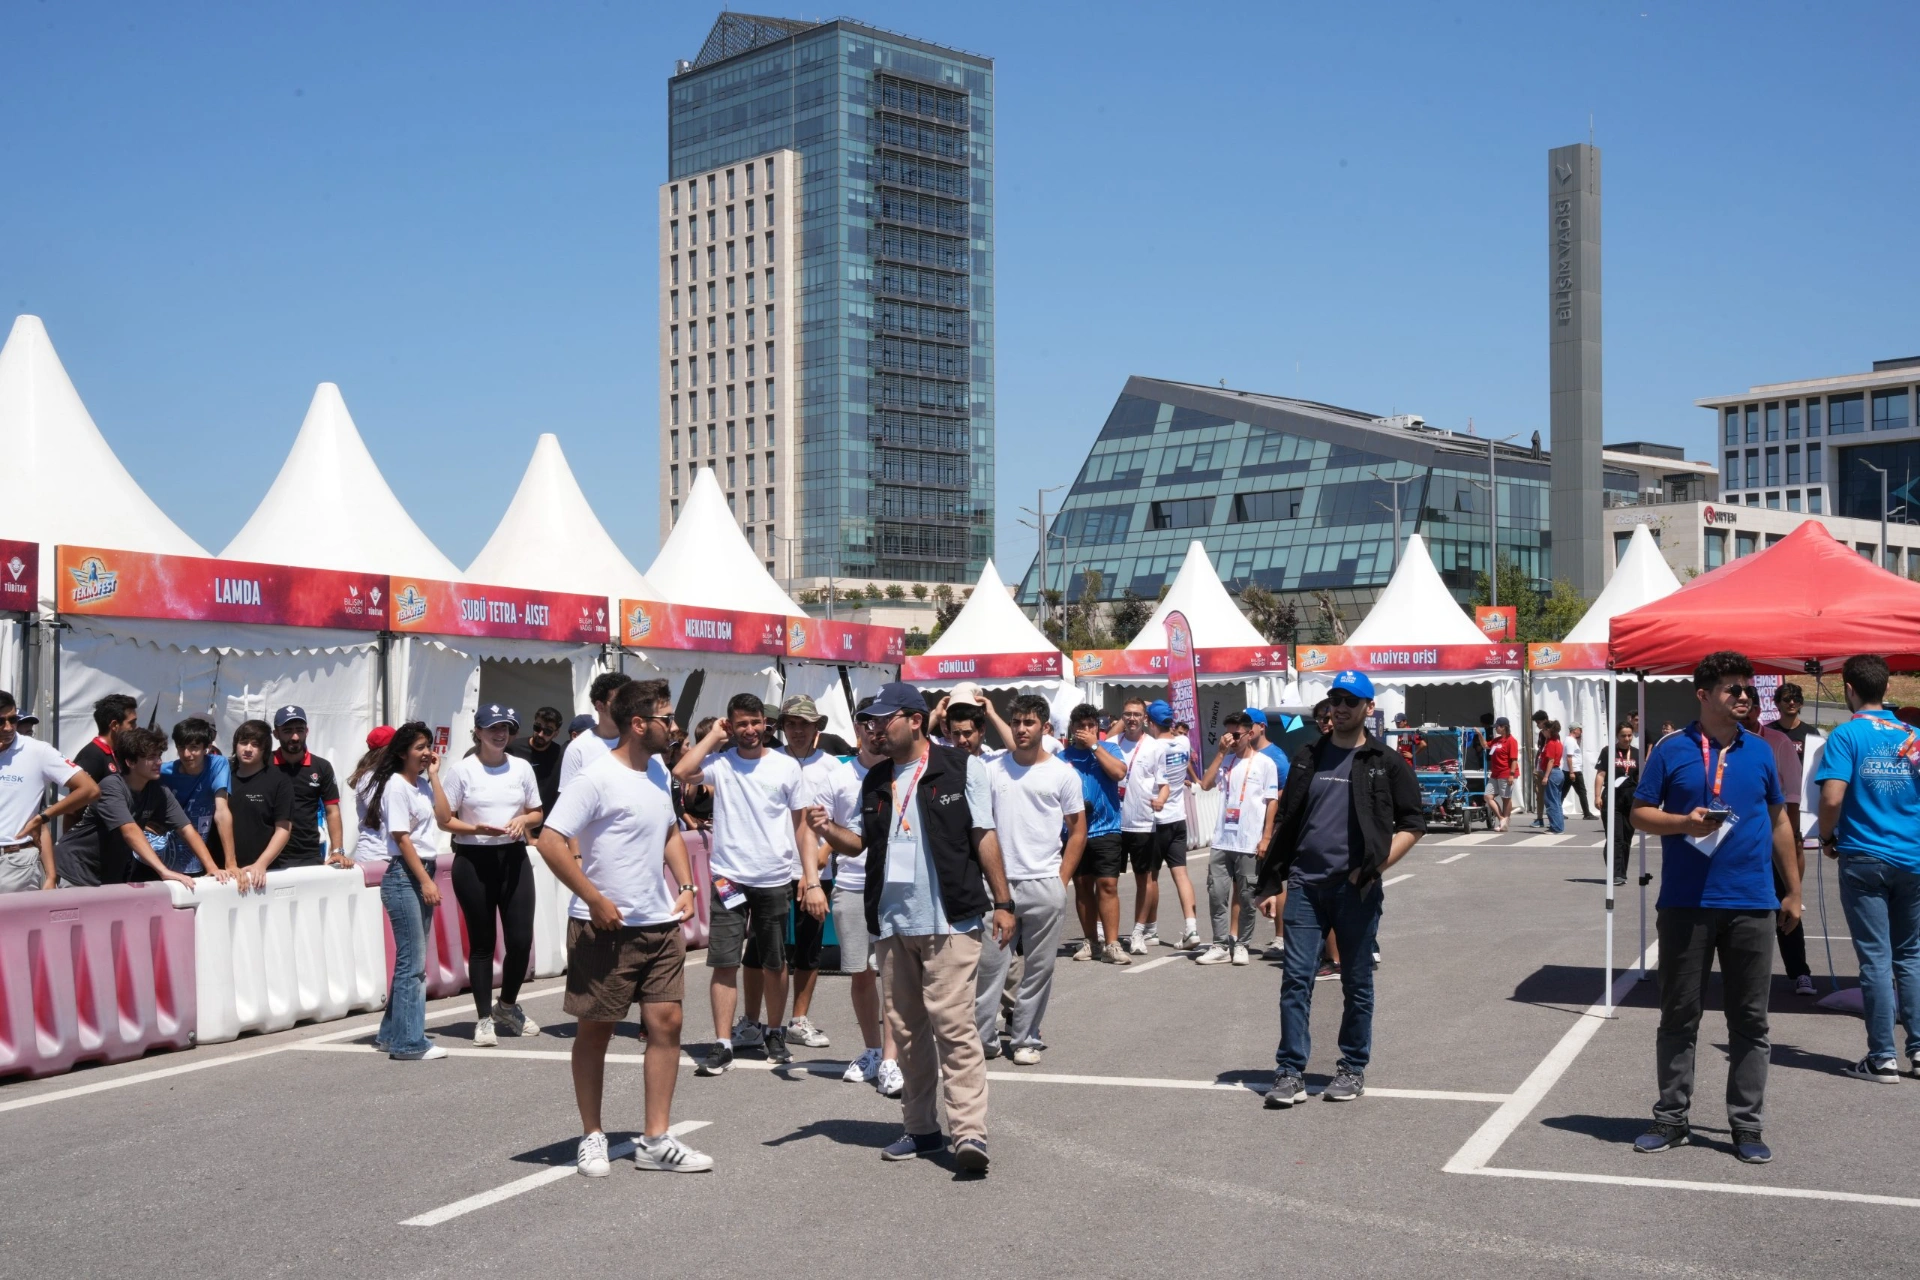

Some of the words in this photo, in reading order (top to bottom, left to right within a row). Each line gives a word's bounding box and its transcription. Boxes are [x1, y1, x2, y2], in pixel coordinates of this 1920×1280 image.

[4, 582, 27, 593] TÜBİTAK
[72, 579, 117, 601] TEKNOFEST
[215, 578, 261, 606] LAMDA
[461, 597, 486, 621] SUBÜ
[488, 601, 517, 623] TETRA
[685, 618, 716, 639] MEKATEK
[1150, 656, 1161, 668] 42
[1370, 649, 1410, 664] KARİYER
[1412, 648, 1437, 664] OFİSİ
[938, 658, 975, 673] GÖNÜLLÜ
